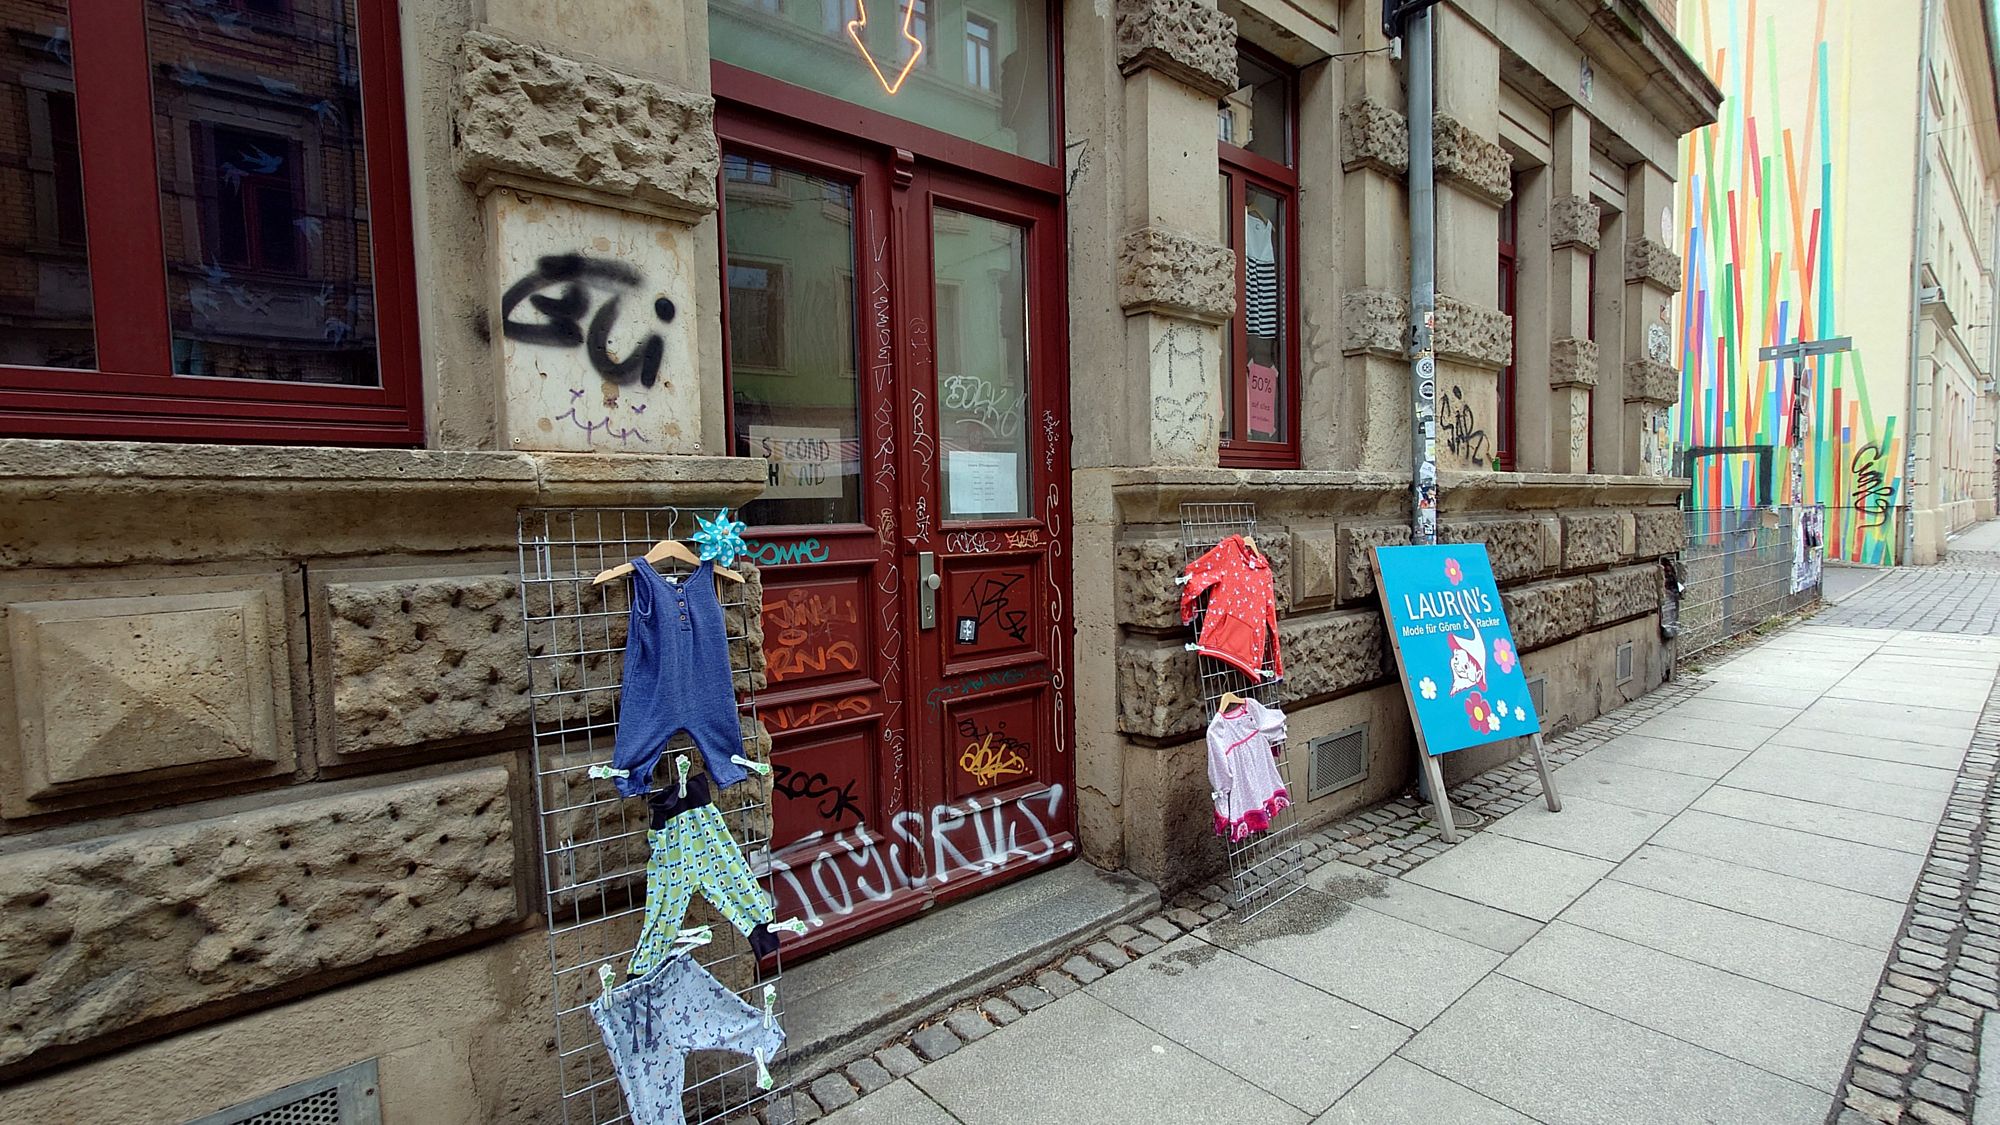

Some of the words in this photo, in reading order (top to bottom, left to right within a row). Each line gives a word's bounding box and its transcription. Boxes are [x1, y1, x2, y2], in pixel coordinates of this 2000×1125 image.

[1251, 375, 1272, 394] 50%
[762, 437, 830, 461] SECOND
[768, 462, 826, 487] HAND
[1404, 586, 1492, 620] LAURIN's
[1402, 624, 1424, 637] Mode
[1426, 622, 1437, 635] für
[1438, 621, 1462, 633] Gören
[1463, 619, 1469, 630] &
[1476, 616, 1500, 628] Racker
